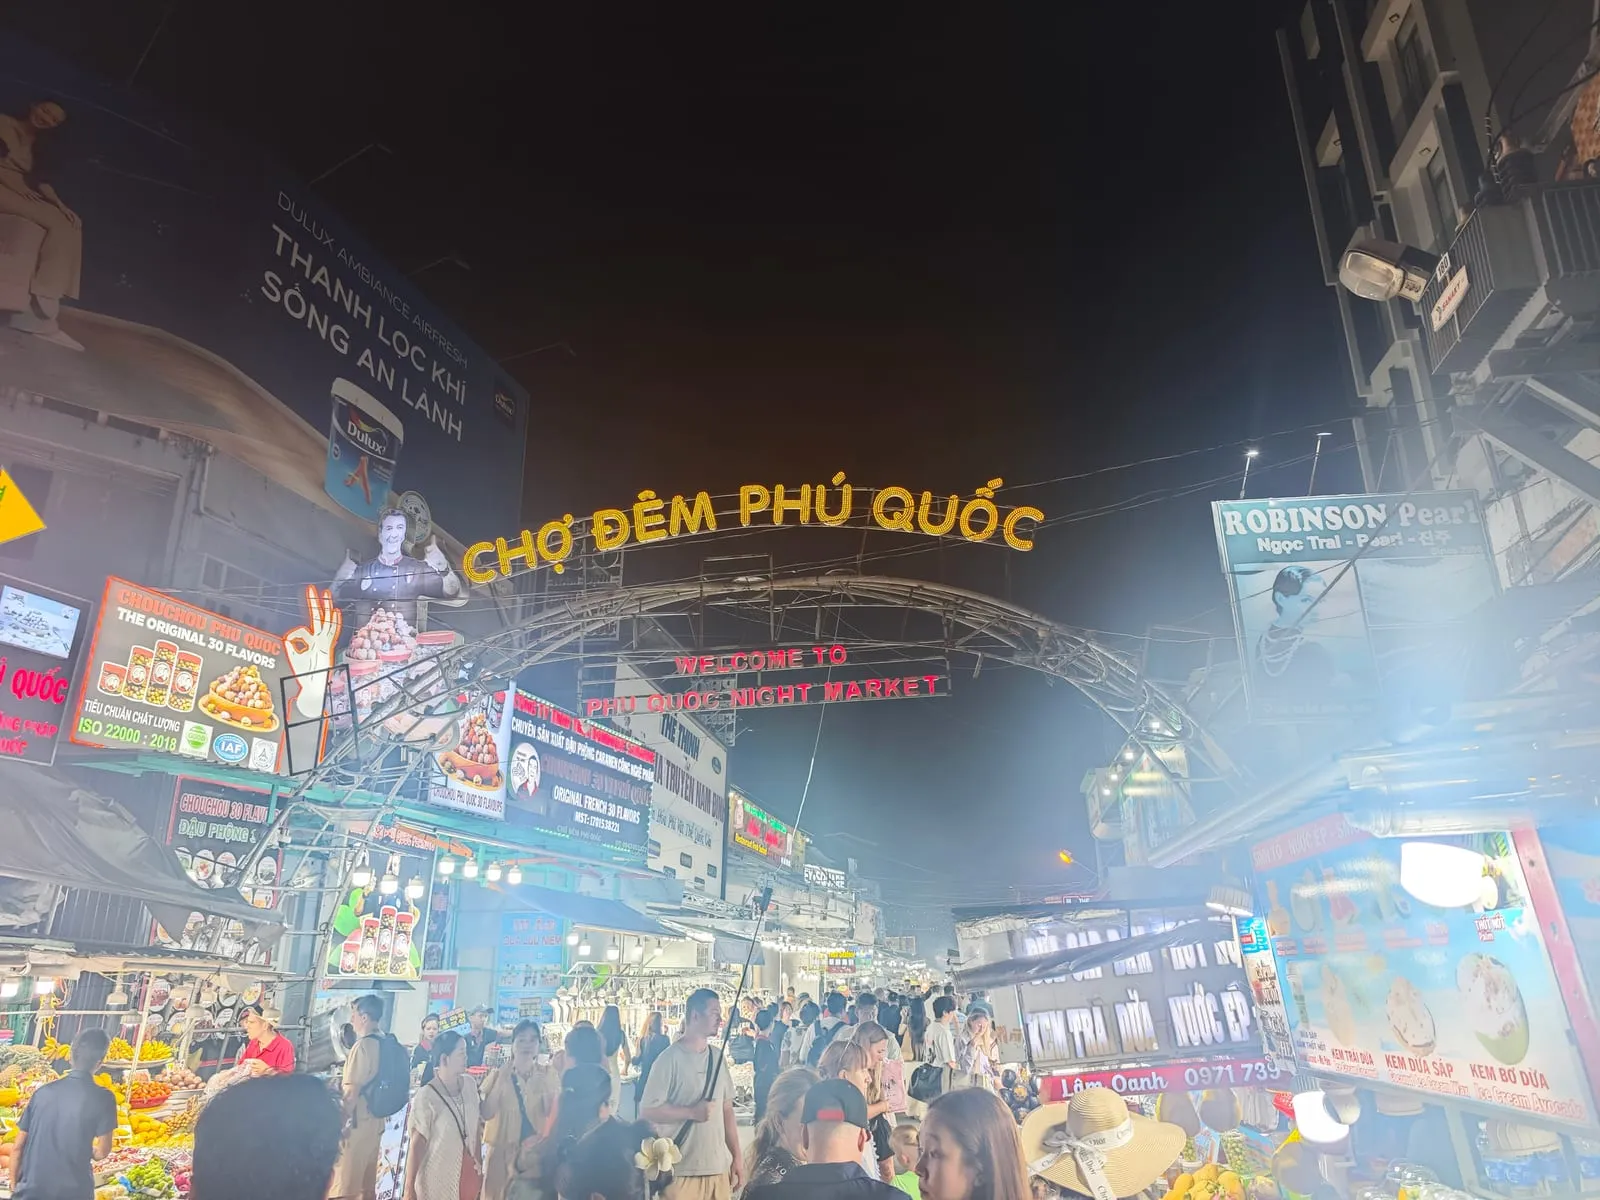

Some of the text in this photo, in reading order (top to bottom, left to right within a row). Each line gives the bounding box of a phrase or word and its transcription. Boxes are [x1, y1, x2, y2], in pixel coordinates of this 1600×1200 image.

[277, 190, 468, 369] DULUX AMBIANCE AIRFRESH
[272, 222, 467, 405] THANH LỌC KHÍ
[261, 270, 464, 441] SỐNG AN LÀNH
[347, 421, 387, 456] Dulux
[462, 471, 1046, 585] CHỢ ĐÊM PHÚ QUỐC
[1223, 499, 1480, 536] ROBINSON Pearl
[1257, 535, 1305, 555] Ngọc
[116, 588, 207, 630] CHOUCHOU
[116, 607, 276, 669] THE ORIGINAL 30 FLAVORS
[674, 644, 848, 677] WELCOME TO
[11, 665, 69, 705] QUỐC
[586, 675, 940, 718] PHU QUOC NIGHT MARKET
[84, 698, 181, 733] TIÊU CHUẨN CHẤT LƯỢNG
[511, 716, 537, 739] CHUYÊN
[536, 723, 550, 743] SẢN
[78, 717, 103, 736] ISO
[104, 722, 141, 744] 22000
[150, 733, 177, 751] 2018
[220, 741, 242, 754] IAF
[180, 792, 231, 818] CHOUCHOU
[230, 802, 243, 820] 30
[553, 785, 641, 825] ORIGINAL FRENCH 30 FLAVORS
[178, 817, 207, 839] ĐẬU
[208, 822, 249, 843] PHỘNG
[1168, 981, 1225, 1047] NƯỚC
[1331, 1048, 1344, 1061] KEM
[1384, 1054, 1454, 1079] KEM DỪA SÁP
[1061, 1062, 1281, 1097] Lâm Oanh 0971 739
[1469, 1063, 1551, 1091] KEM BƠ DỪA
[1473, 1082, 1492, 1101] Ice
[1492, 1085, 1532, 1110] Cream
